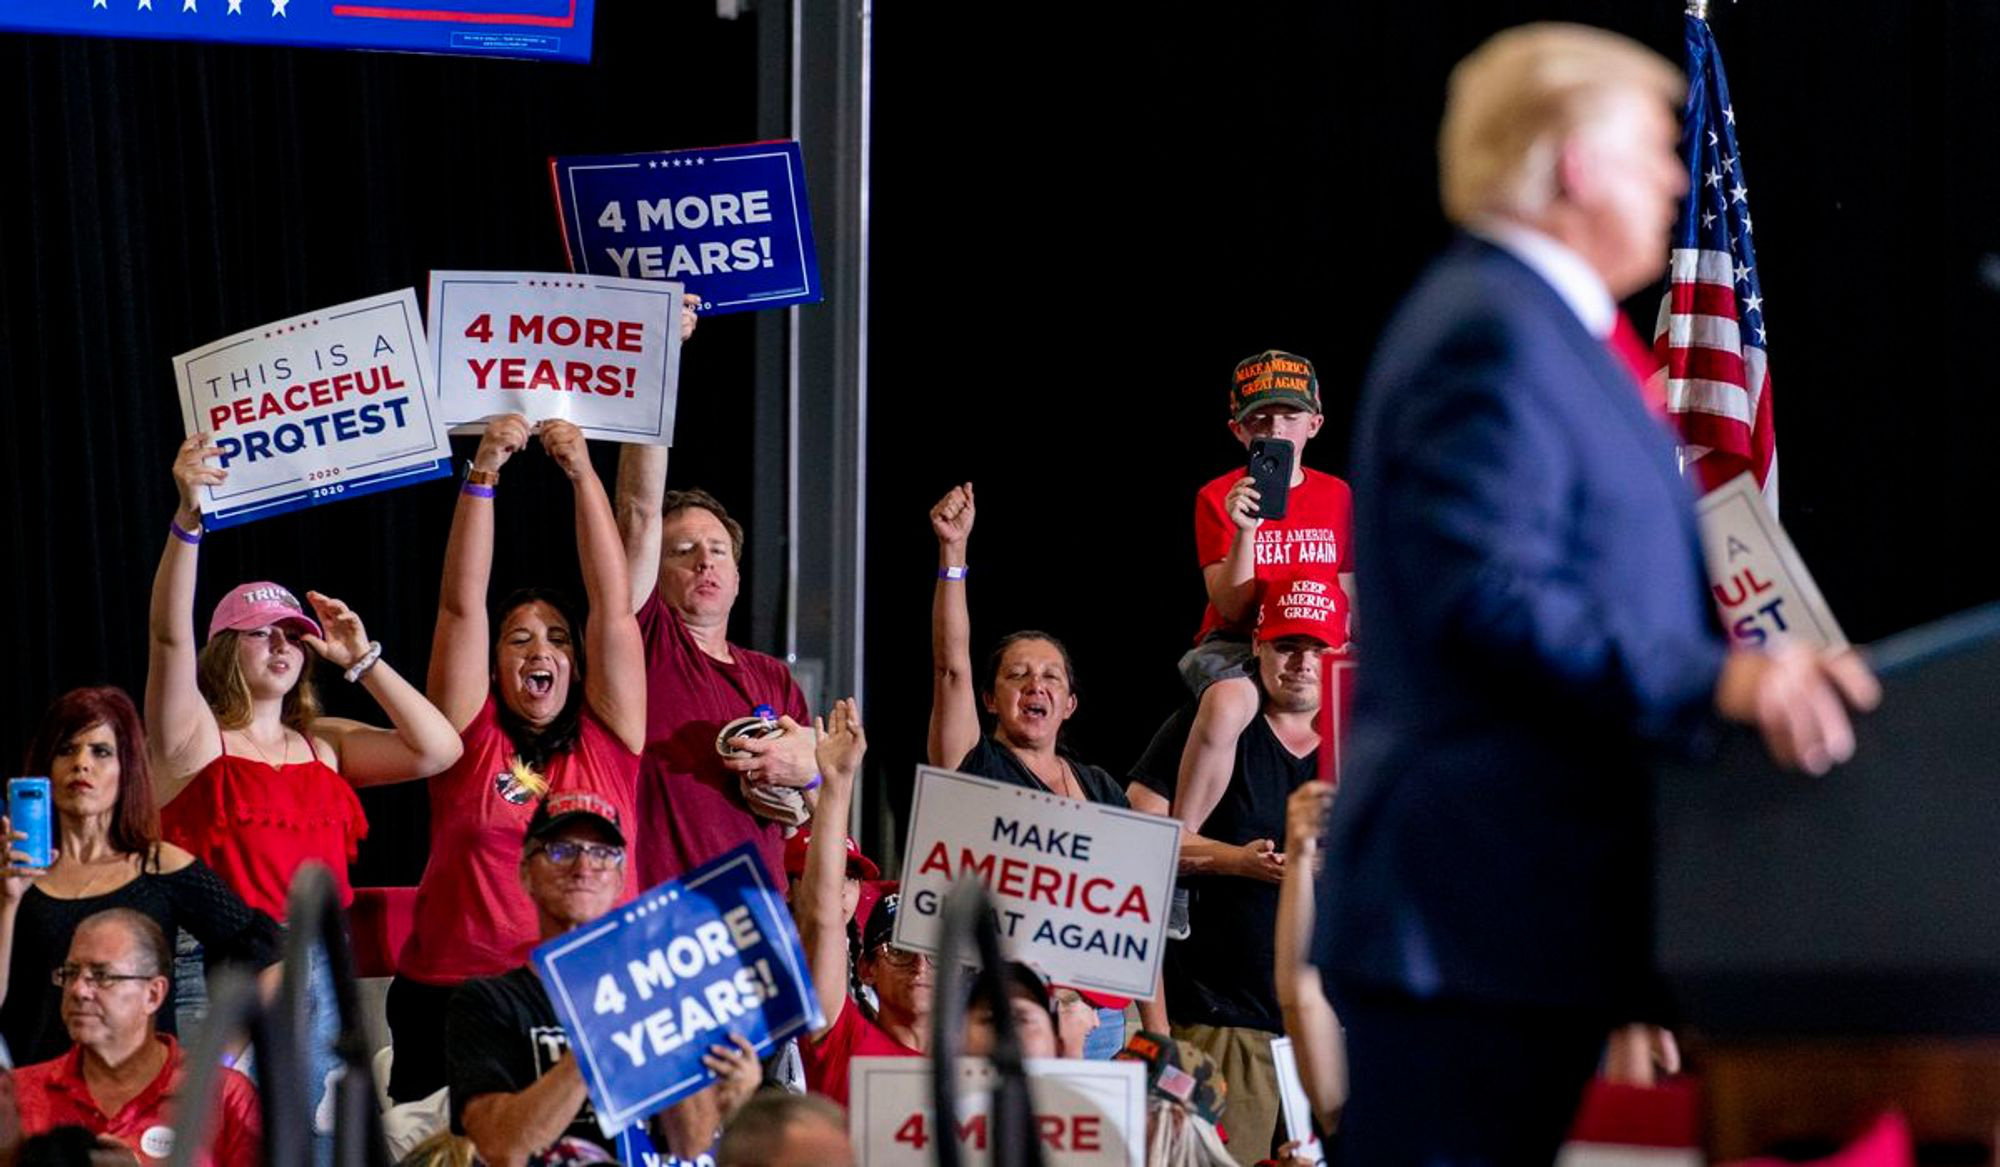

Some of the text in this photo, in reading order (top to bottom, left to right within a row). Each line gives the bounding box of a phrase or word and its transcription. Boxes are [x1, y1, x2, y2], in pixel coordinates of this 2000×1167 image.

[598, 190, 772, 232] 4 MORE
[605, 237, 774, 278] YEARS!
[465, 314, 644, 352] 4 MORE
[206, 335, 394, 398] THIS IS A
[467, 358, 637, 398] YEARS!
[1237, 359, 1310, 380] MAKE AMERICA
[1241, 376, 1272, 397] GREAT
[210, 365, 404, 431] PEACEFUL
[309, 468, 341, 481] 2020
[312, 485, 345, 498] 2020
[1254, 528, 1335, 543] AKE AMERICA
[1254, 542, 1337, 565] REAT AGAIN
[1277, 593, 1336, 612] AMERICA
[1292, 580, 1328, 594] KEEP
[1713, 567, 1773, 607] UL
[1284, 606, 1328, 621] GREAT
[1734, 597, 1788, 646] ST
[992, 816, 1093, 861] MAKE
[919, 841, 1151, 923] AMERICA
[594, 905, 762, 1014] 4 MORE
[1033, 920, 1148, 961] AGAIN
[612, 959, 778, 1067] YEARS!
[895, 1112, 1102, 1152] 4 MRE
